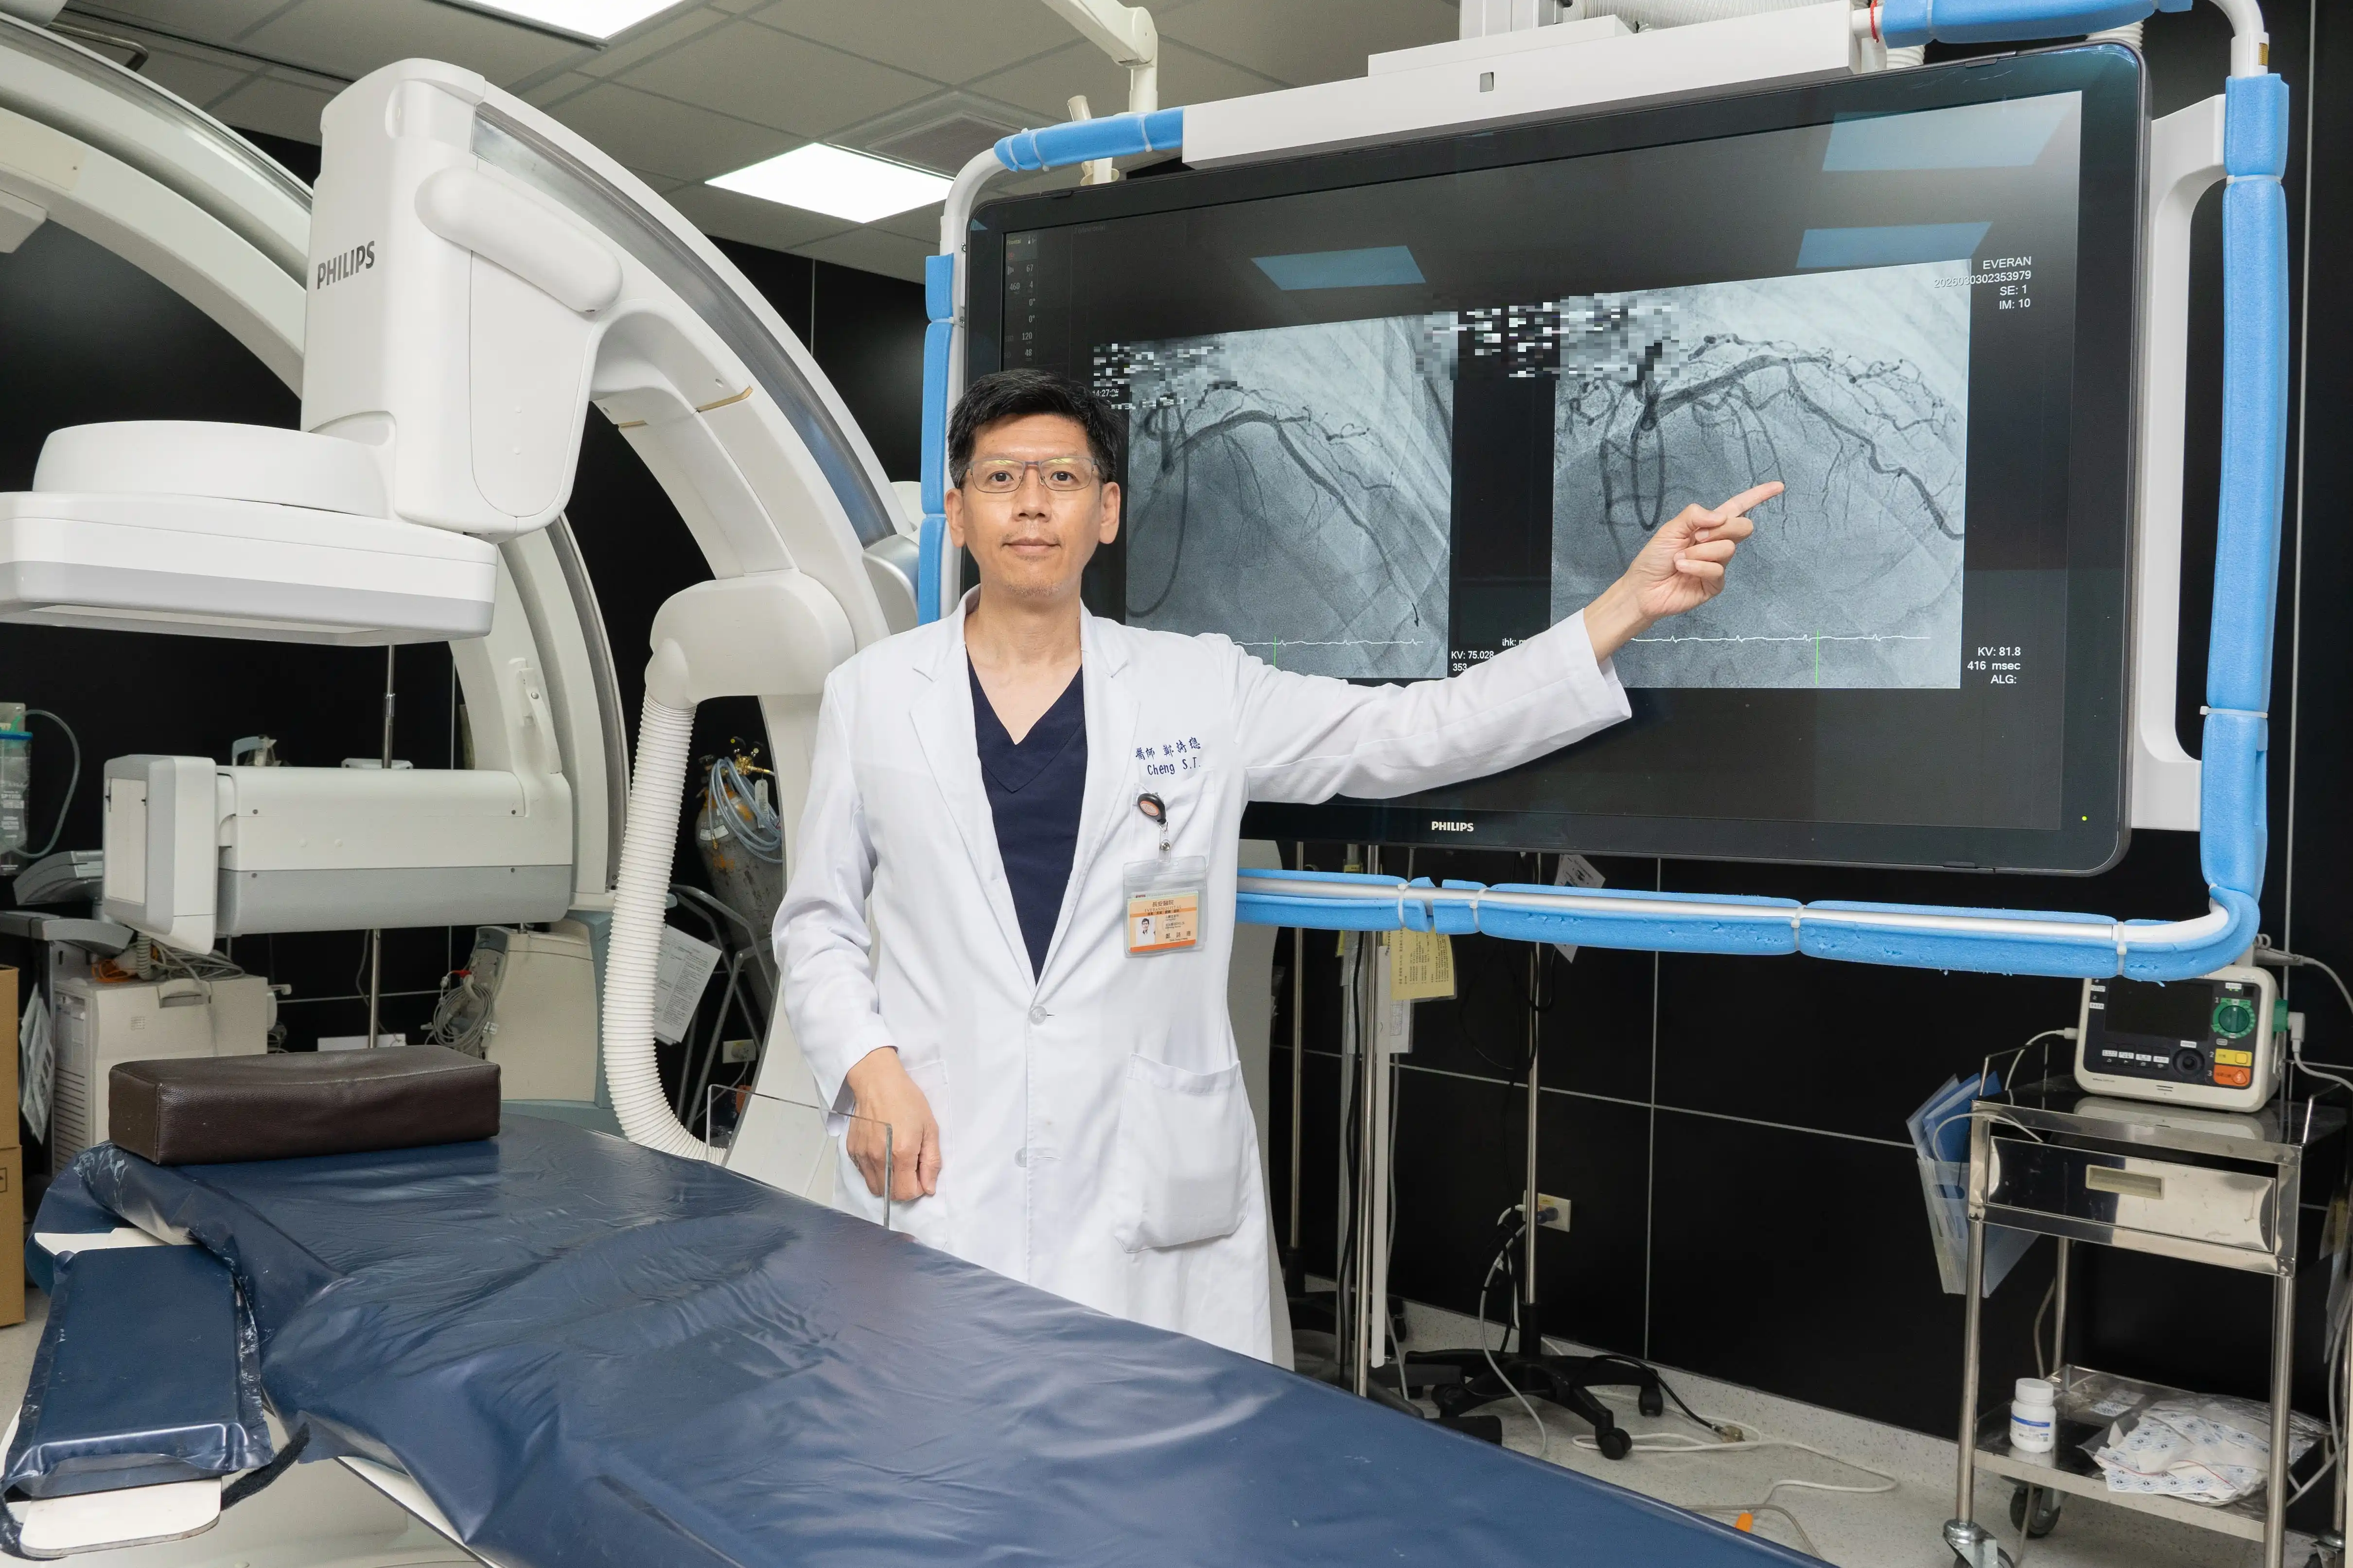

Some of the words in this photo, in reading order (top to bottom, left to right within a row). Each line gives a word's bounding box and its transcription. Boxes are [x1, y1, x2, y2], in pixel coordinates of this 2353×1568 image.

[317, 240, 375, 290] PHILIPS
[1026, 264, 1034, 272] 67
[1983, 256, 2032, 270] EVERAN
[1934, 270, 2032, 289] 2026030302353979
[1009, 282, 1020, 291] 460
[2000, 285, 2019, 296] SE:
[2022, 284, 2027, 294] 1
[1999, 300, 2015, 310] IM:
[2018, 298, 2031, 308] 10
[1021, 331, 1033, 340] 120
[1025, 348, 1032, 356] 48
[1451, 651, 1466, 659] KV:
[1468, 650, 1494, 659] 75.028
[1977, 646, 1996, 656] KV:
[1999, 646, 2021, 656] 81.8
[1452, 663, 1467, 671] 353
[1967, 661, 1986, 670] 416
[1990, 674, 2017, 684] ALG:
[1147, 764, 1175, 776] Cheng
[1182, 757, 1201, 770] S.T.
[1431, 821, 1474, 832] PHILIPS
